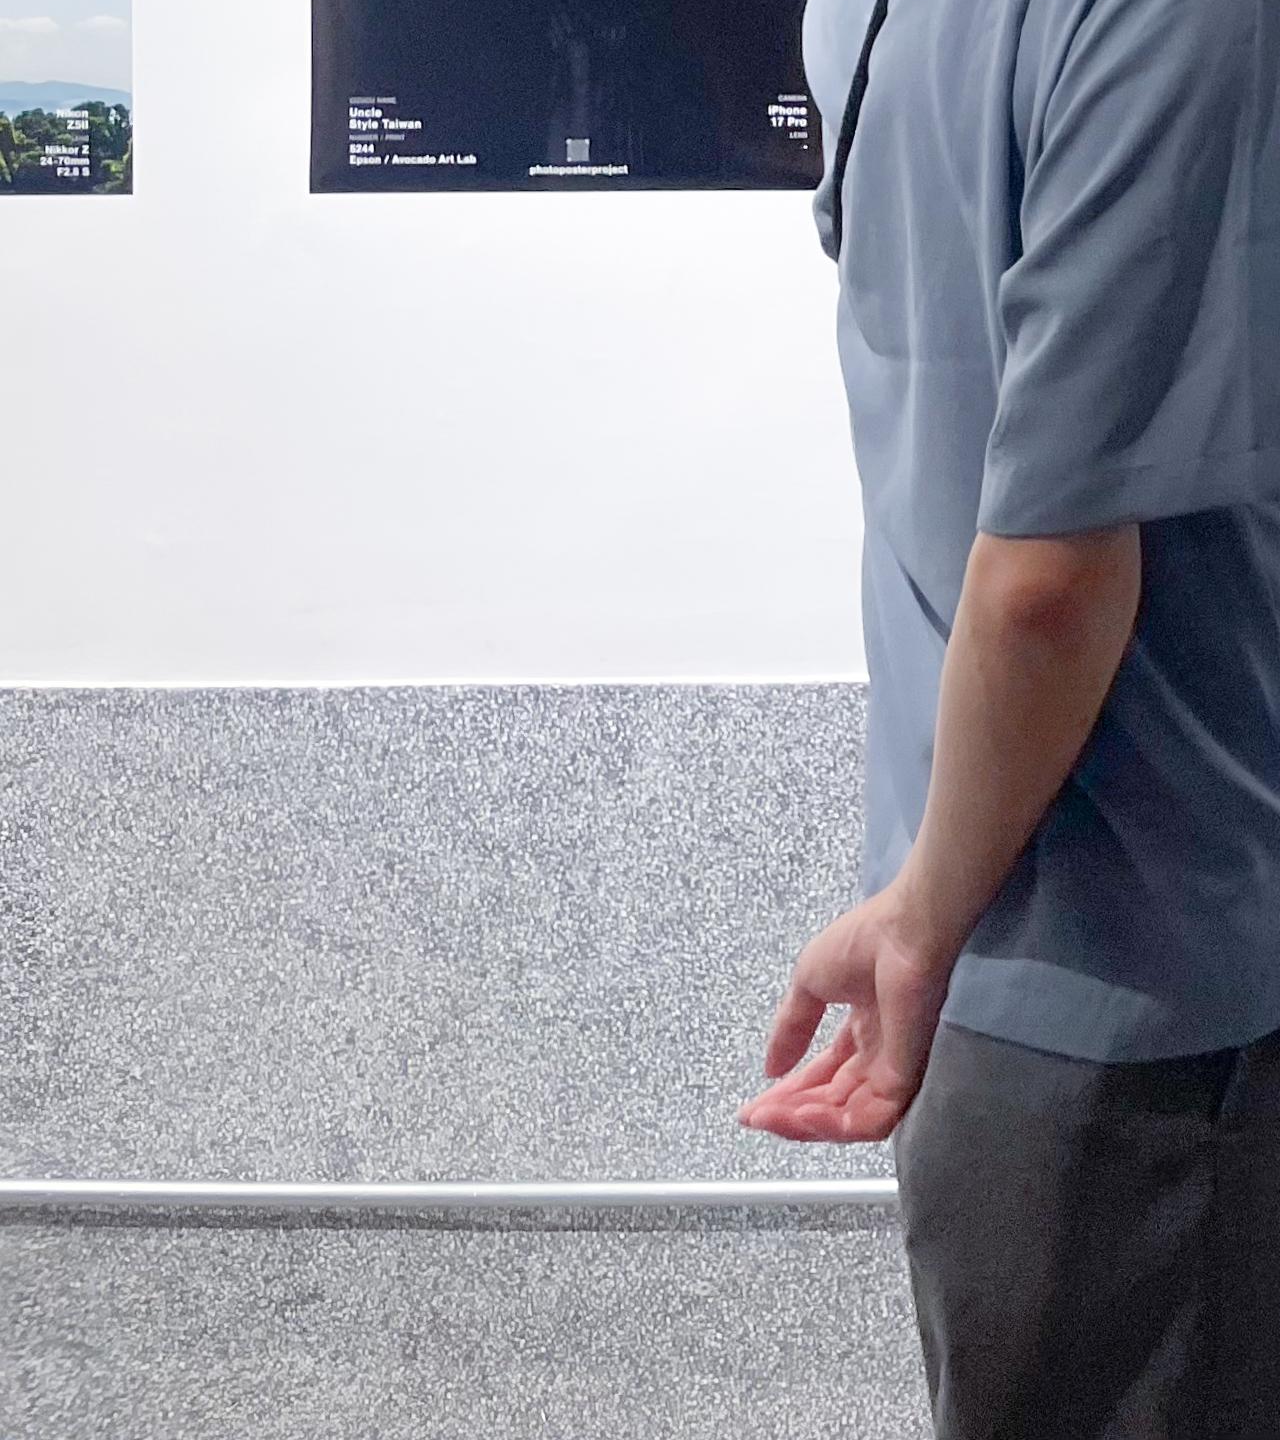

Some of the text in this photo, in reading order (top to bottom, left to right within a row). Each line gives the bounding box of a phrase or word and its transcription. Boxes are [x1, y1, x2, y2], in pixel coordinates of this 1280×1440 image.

[56, 109, 89, 118] Nikon
[349, 107, 383, 118] Uncle
[767, 104, 808, 116] iPhone
[349, 119, 422, 131] Style Taiwan
[770, 116, 808, 128] 17 Pro
[45, 144, 90, 155] Nikkor Z
[40, 156, 90, 166] 24-70mm
[349, 154, 382, 166] Epson
[391, 154, 436, 165] Avocado
[438, 154, 455, 165] Art
[456, 154, 477, 165] Lab
[529, 164, 629, 176] photoposterproject
